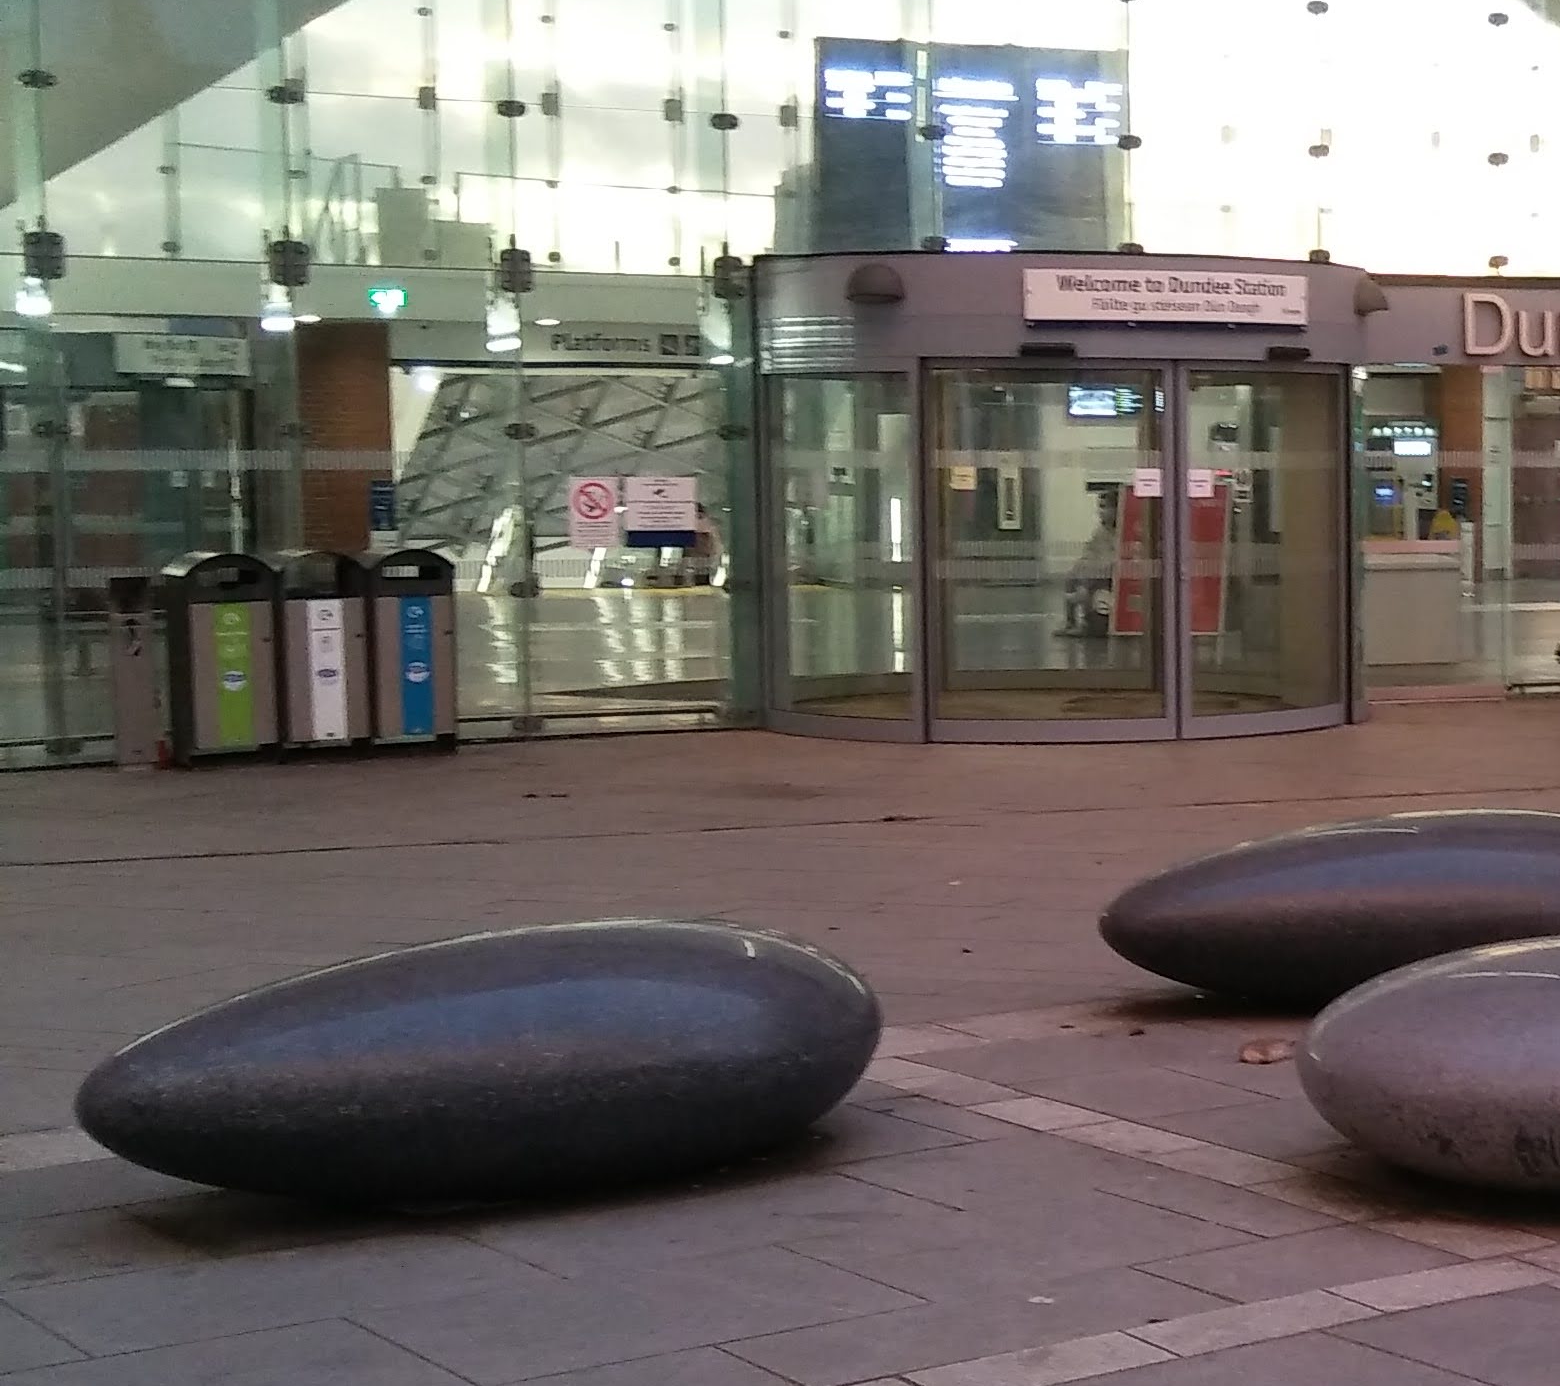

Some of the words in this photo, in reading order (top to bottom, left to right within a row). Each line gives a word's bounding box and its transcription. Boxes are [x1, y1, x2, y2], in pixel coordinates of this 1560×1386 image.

[1056, 274, 1142, 294] Welcome
[1145, 276, 1164, 294] to
[1168, 276, 1232, 295] Dundee
[1234, 277, 1288, 297] Station
[550, 332, 650, 352] Platforms
